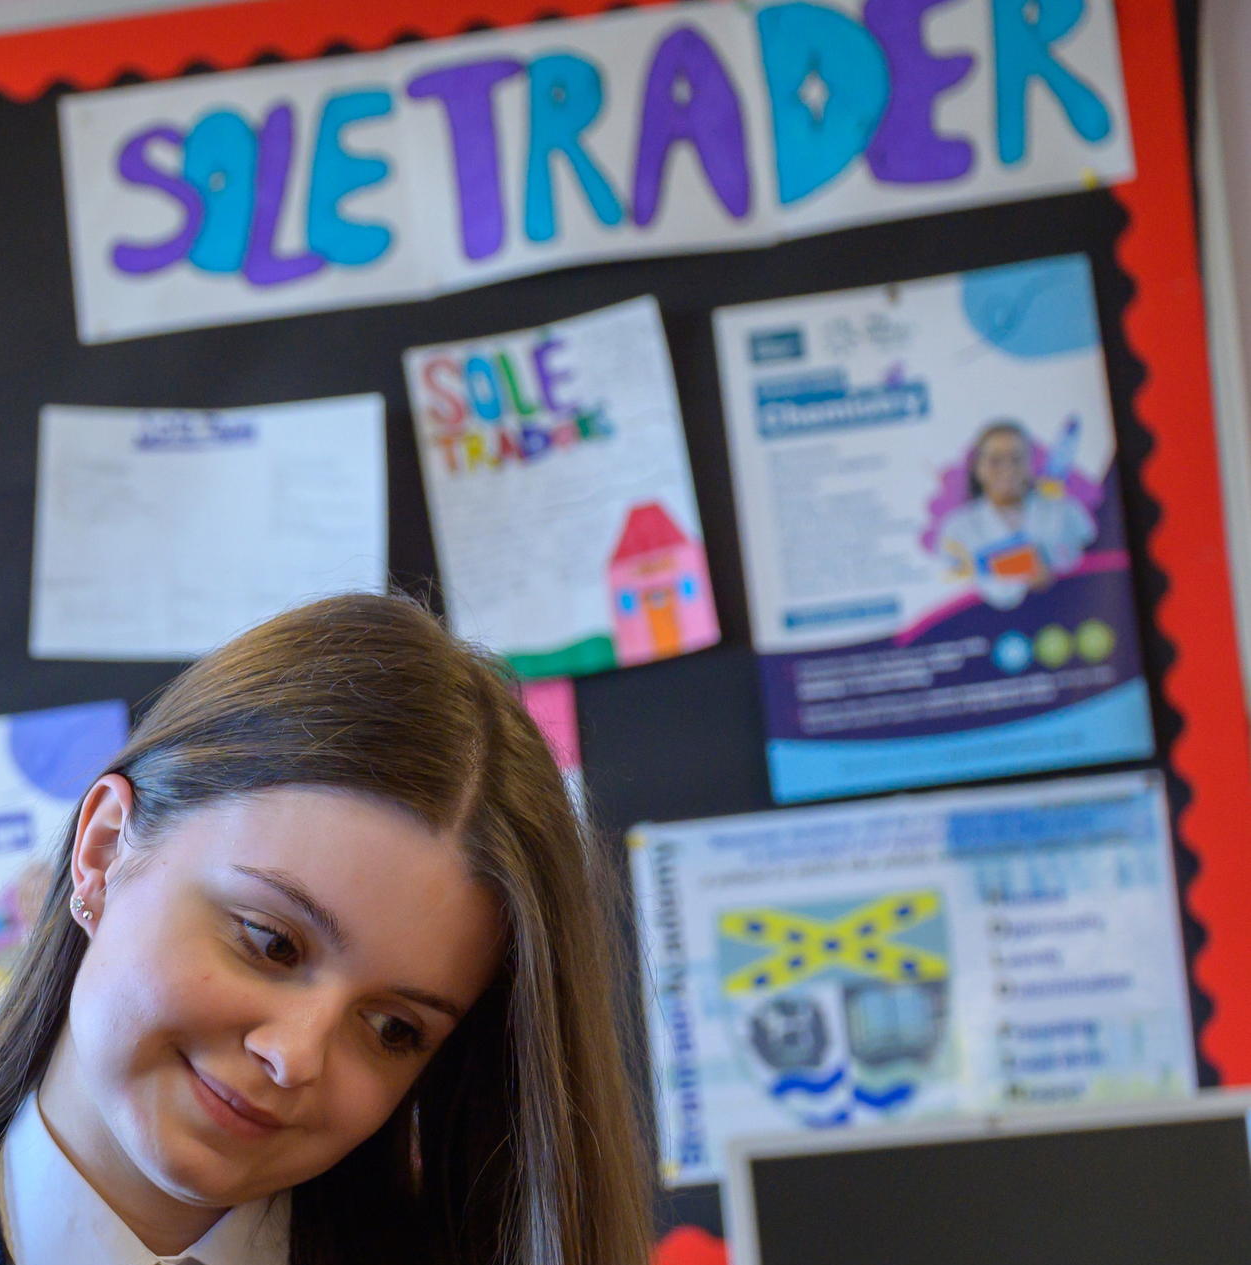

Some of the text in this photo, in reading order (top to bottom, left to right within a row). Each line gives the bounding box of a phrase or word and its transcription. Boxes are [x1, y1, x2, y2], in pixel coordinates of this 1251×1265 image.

[111, 0, 1112, 286] SOLE TRADER
[422, 336, 579, 425] SOLE
